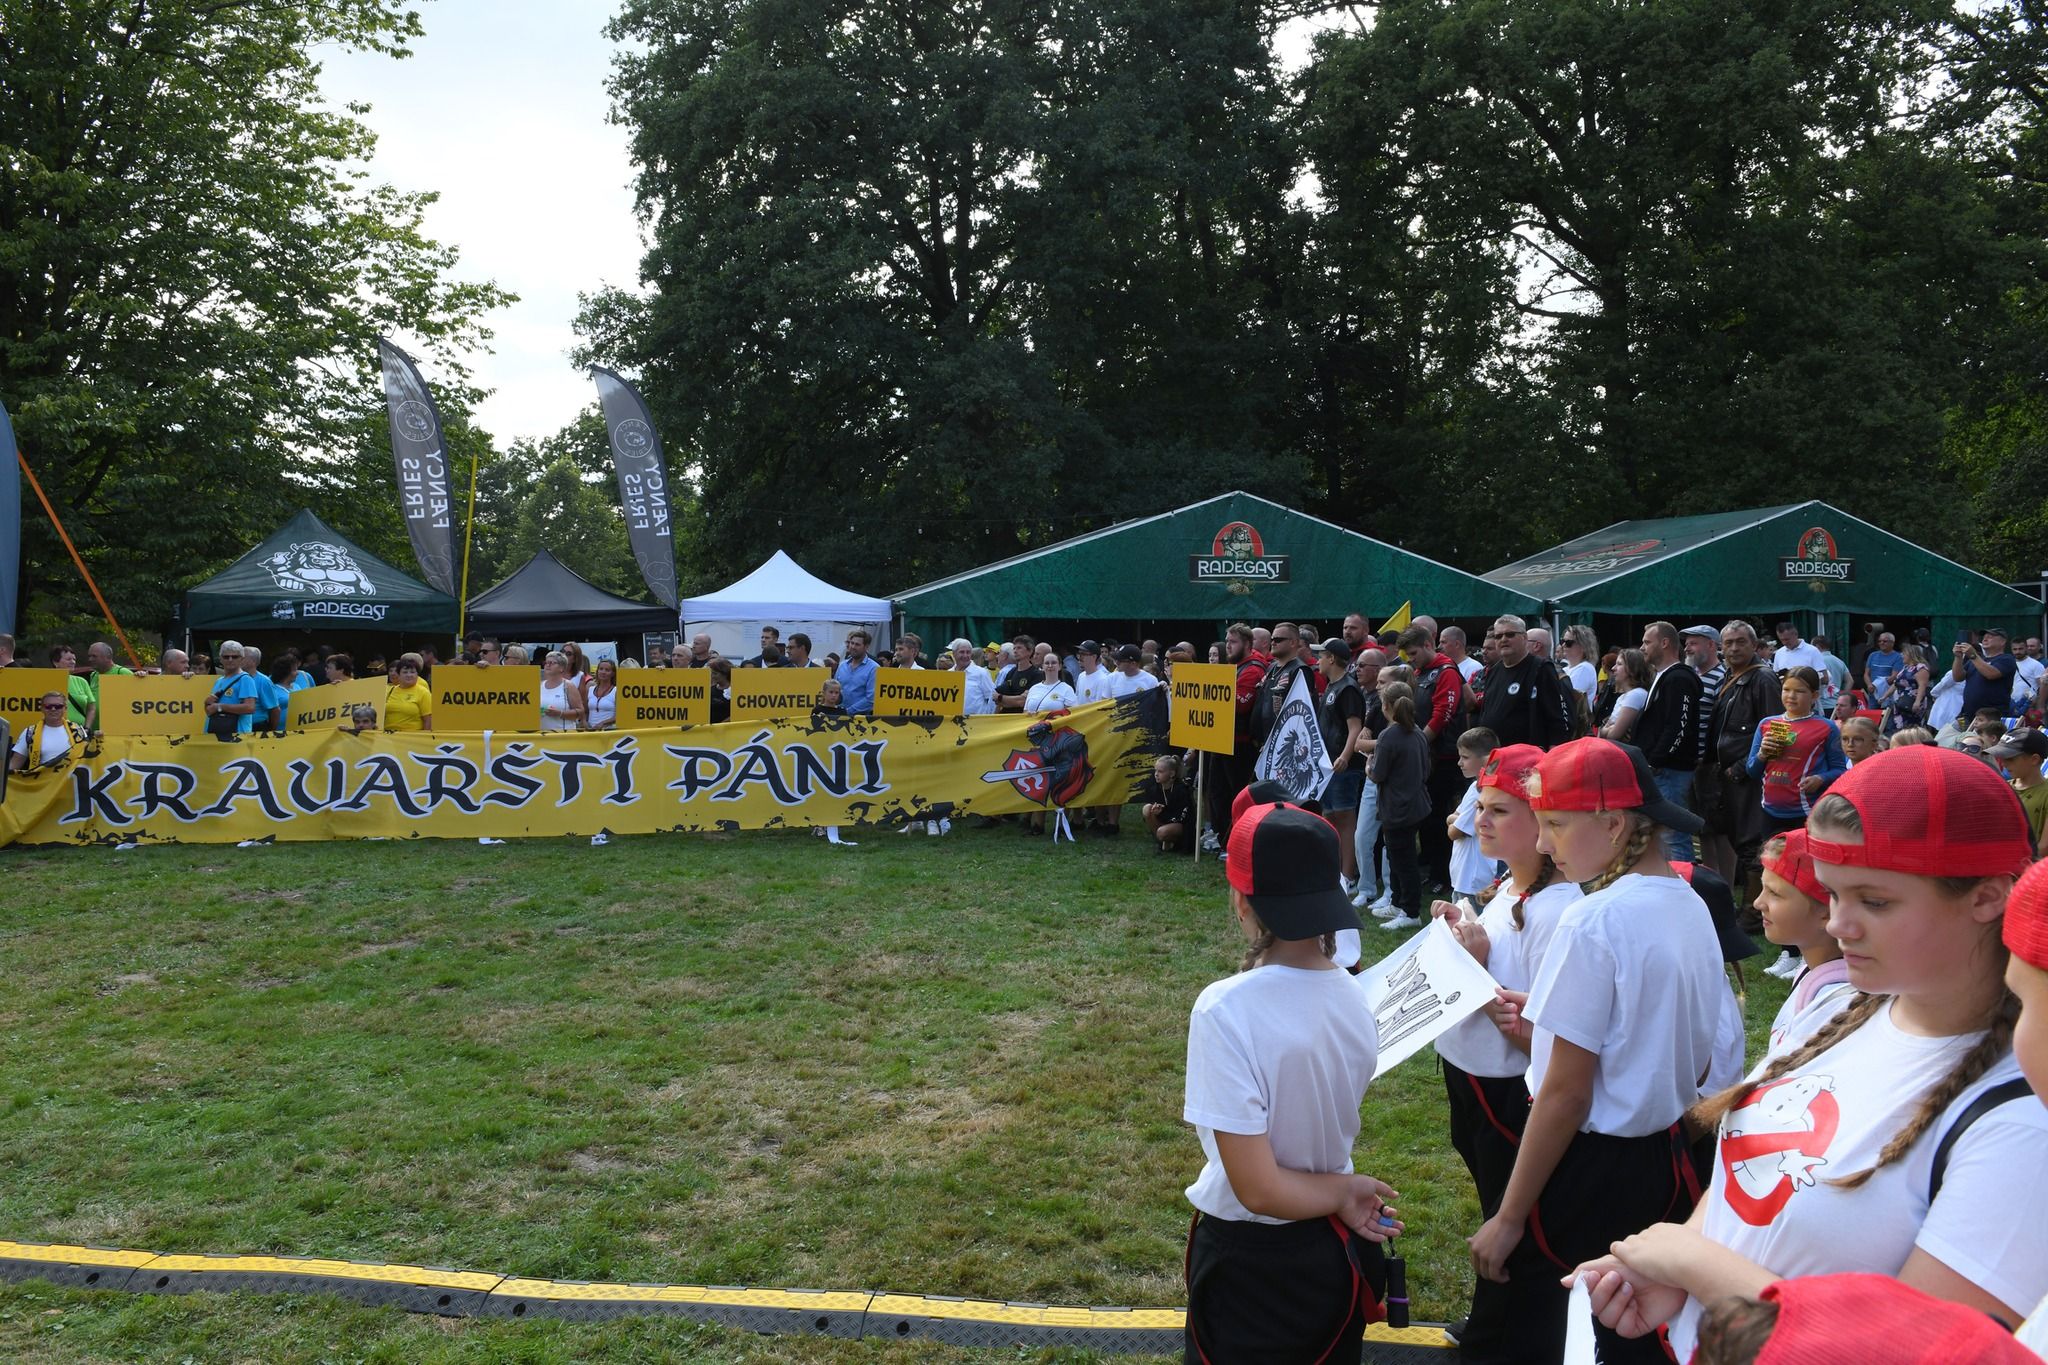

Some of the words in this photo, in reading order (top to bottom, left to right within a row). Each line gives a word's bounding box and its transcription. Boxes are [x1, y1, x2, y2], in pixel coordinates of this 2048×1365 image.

[1198, 560, 1283, 580] RADEGAST
[1785, 561, 1851, 580] RADEGAST
[303, 601, 390, 621] RADEGAST
[441, 691, 530, 706] AQUAPARK
[622, 685, 704, 700] COLLEGIUM
[879, 684, 960, 702] FOTBALOVÝ
[1175, 682, 1200, 699] AUTO
[1203, 684, 1231, 702] MOTO
[131, 700, 194, 715] SPCCH
[297, 707, 337, 726] KLUB
[636, 706, 688, 721] BONUM
[1188, 709, 1215, 728] KLUB
[664, 729, 892, 807] PÁNI
